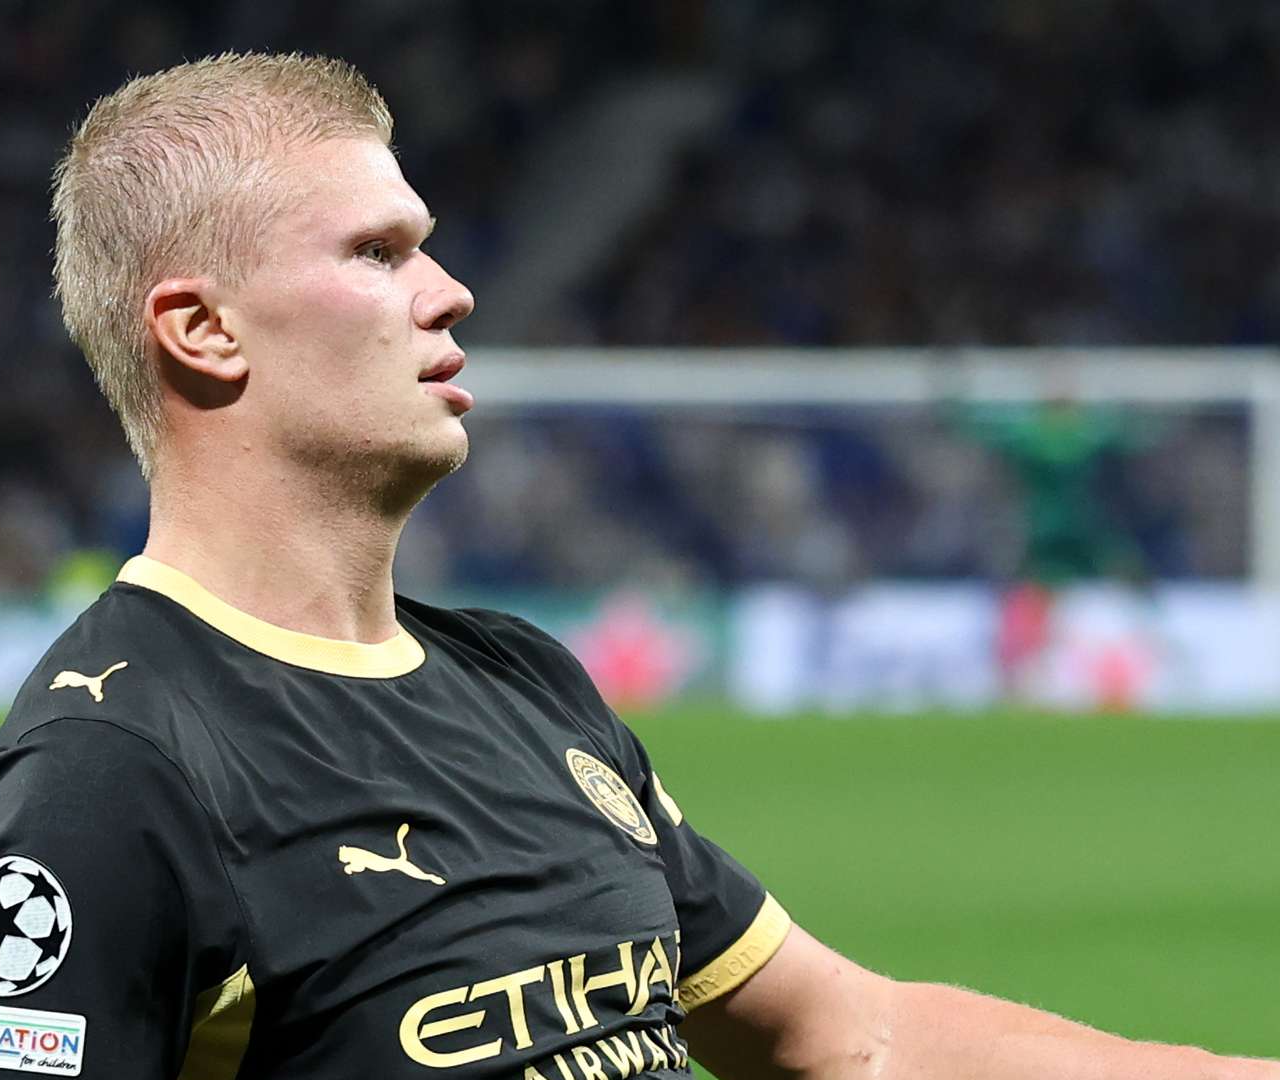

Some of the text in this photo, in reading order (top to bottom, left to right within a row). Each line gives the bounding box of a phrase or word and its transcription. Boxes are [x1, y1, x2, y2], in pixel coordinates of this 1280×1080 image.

[399, 929, 681, 1068] ETIHA
[20, 1054, 78, 1071] for children
